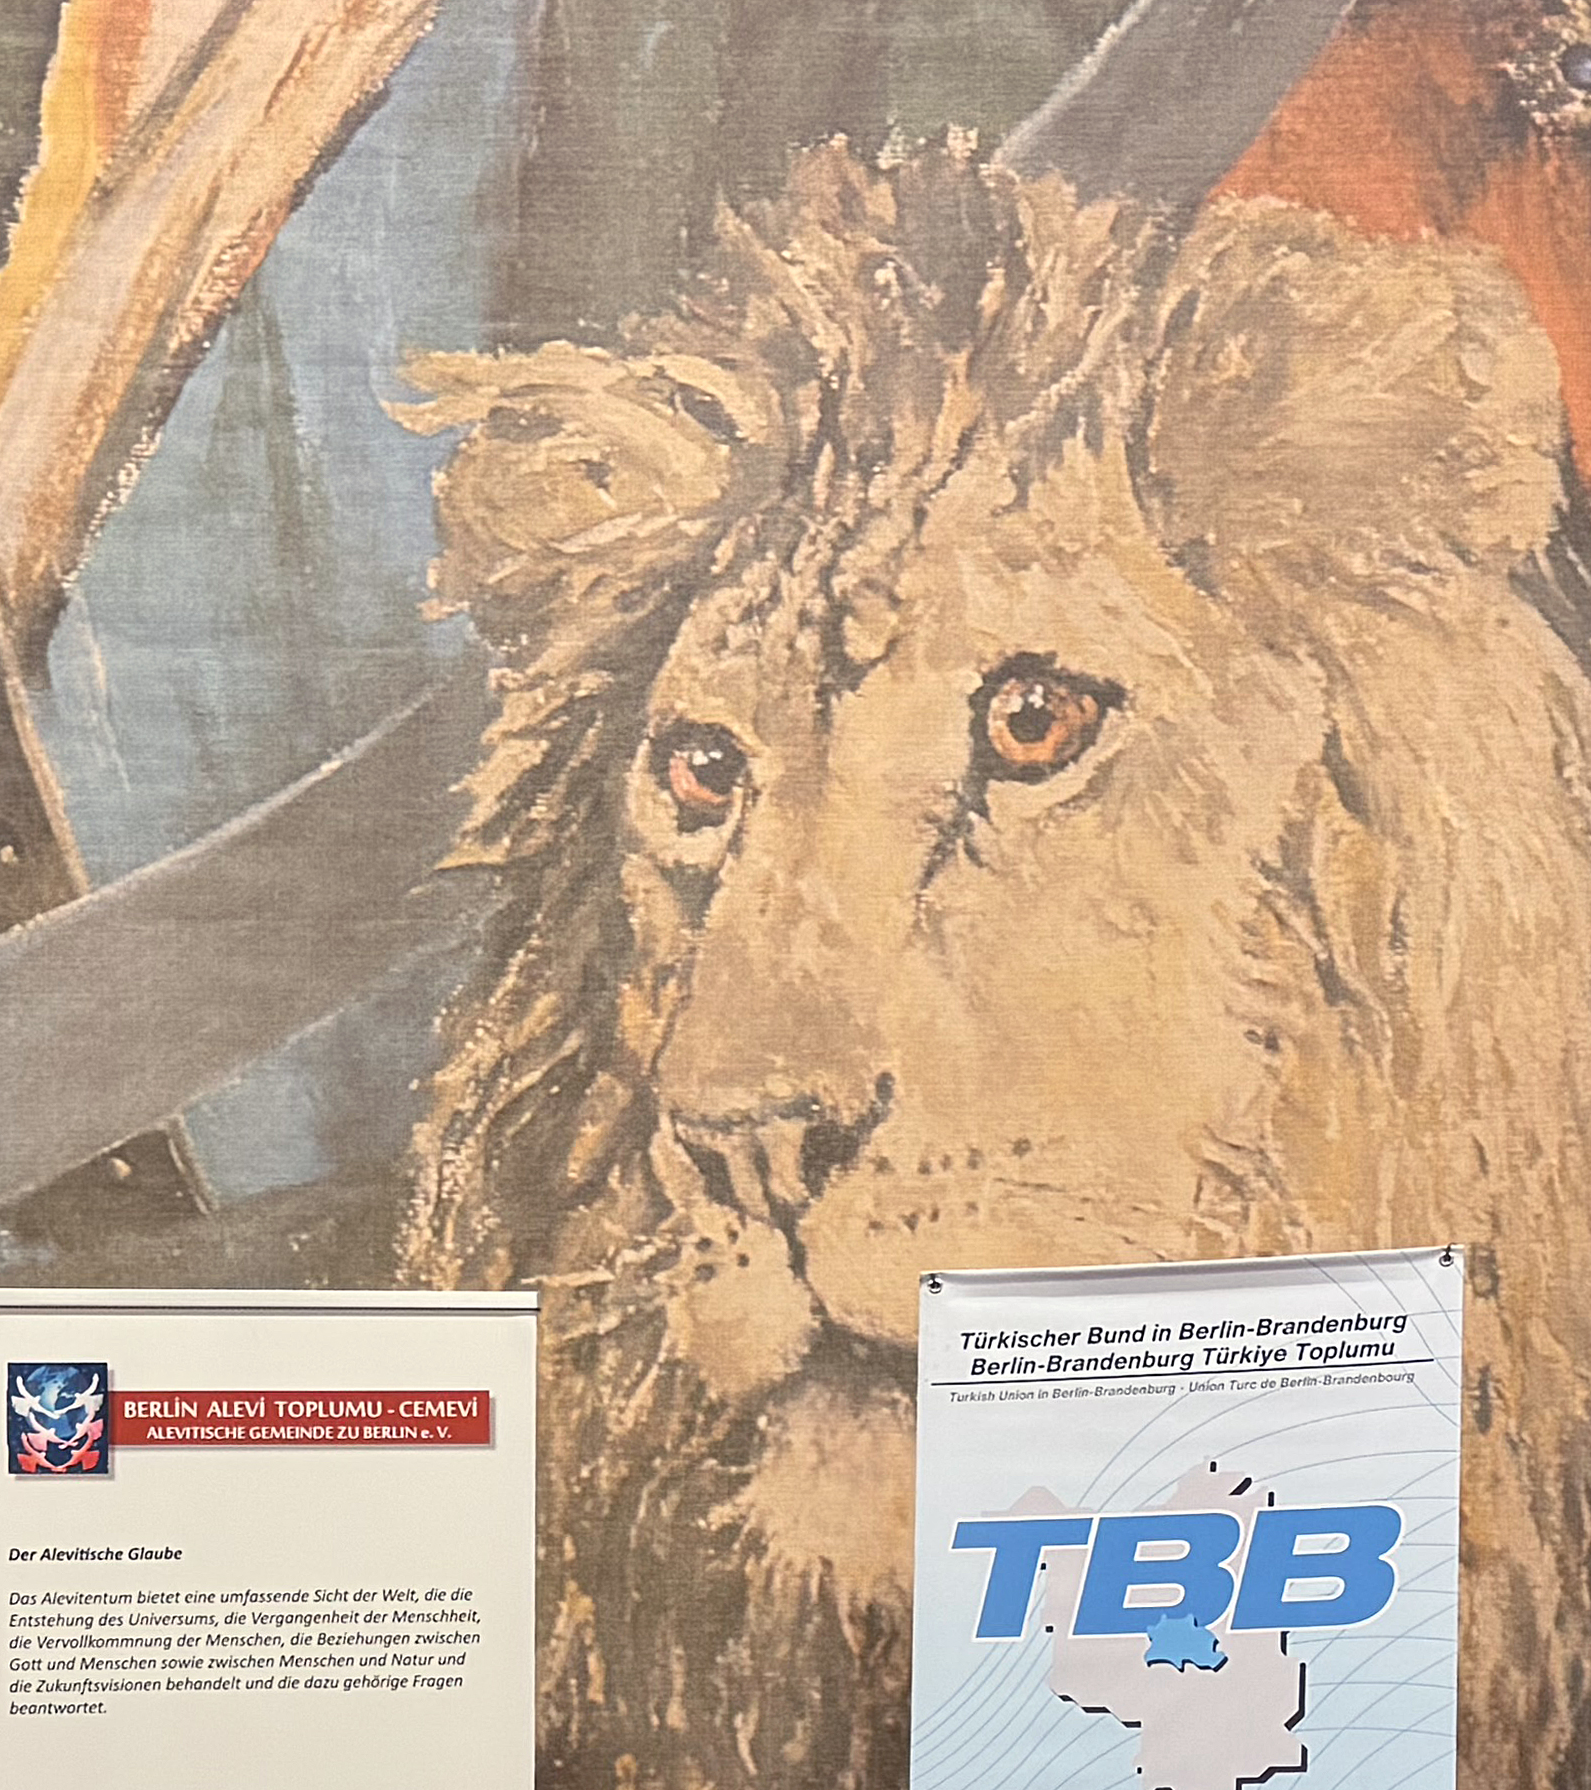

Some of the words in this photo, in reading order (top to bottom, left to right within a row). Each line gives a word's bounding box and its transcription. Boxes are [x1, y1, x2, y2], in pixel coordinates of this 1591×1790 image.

[961, 1330, 1081, 1349] Türkischer
[1088, 1325, 1146, 1344] Bund
[1152, 1324, 1171, 1342] in
[1179, 1313, 1408, 1340] Berlin-Brandenburg
[971, 1352, 1194, 1377] Berlin-Brandenburg
[1203, 1345, 1287, 1367] Türkiye
[1297, 1341, 1394, 1363] Toplumu
[950, 1390, 996, 1403] Turkish
[999, 1389, 1034, 1400] Union
[1038, 1388, 1049, 1399] in
[1053, 1383, 1176, 1399] Berlin-Brandenburg
[1189, 1379, 1226, 1392] Union
[1230, 1379, 1258, 1390] Turc
[1261, 1378, 1277, 1388] de
[125, 1397, 197, 1419] BERLİN
[207, 1397, 264, 1419] ALEVİ
[274, 1401, 382, 1417] TOPLUMU
[399, 1397, 477, 1418] CEMEVİ
[147, 1427, 245, 1441] ALEVITISCHE
[250, 1426, 333, 1441] GEMEINDE
[337, 1426, 359, 1440] ZU
[364, 1426, 417, 1440] BERLIN
[421, 1430, 433, 1440] e.
[437, 1426, 451, 1438] V.
[9, 1548, 37, 1561] Der
[40, 1547, 123, 1561] Alevitische
[128, 1547, 182, 1560] Glaube
[949, 1503, 1405, 1642] TBB
[10, 1593, 36, 1605] Das
[41, 1592, 132, 1605] Alevitentum
[137, 1591, 180, 1604] bietet
[185, 1593, 215, 1603] eine
[221, 1589, 309, 1606] umfassende
[313, 1589, 348, 1602] Sicht
[353, 1589, 377, 1602] der
[383, 1589, 419, 1603] Welt,
[425, 1588, 446, 1601] die
[451, 1588, 472, 1601] die
[9, 1614, 94, 1629] Entstehung
[99, 1613, 123, 1626] des
[129, 1613, 218, 1627] Universums,
[224, 1612, 246, 1625] die
[252, 1610, 359, 1627] Vergangenheit
[364, 1611, 388, 1623] der
[392, 1610, 480, 1624] Menschheit,
[10, 1636, 32, 1649] die
[38, 1635, 172, 1650] Vervollkommnung
[177, 1634, 201, 1647] der
[206, 1633, 284, 1648] Menschen,
[291, 1633, 312, 1645] die
[317, 1632, 410, 1648] Beziehungen
[415, 1631, 480, 1644] zwischen
[10, 1658, 42, 1671] Gott
[47, 1657, 76, 1670] und
[80, 1656, 156, 1670] Menschen
[161, 1656, 203, 1669] sowie
[208, 1655, 274, 1668] zwischen
[279, 1654, 354, 1667] Menschen
[359, 1653, 387, 1666] und
[391, 1654, 434, 1666] Natur
[438, 1652, 466, 1665] und
[10, 1680, 32, 1693] die
[36, 1678, 161, 1695] Zukunftsvisionen
[166, 1677, 241, 1690] behandelt
[246, 1676, 274, 1689] und
[278, 1676, 299, 1689] die
[304, 1676, 339, 1688] dazu
[344, 1675, 408, 1691] gehörige
[413, 1675, 462, 1690] Fragen
[10, 1702, 106, 1715] beantwortet.
